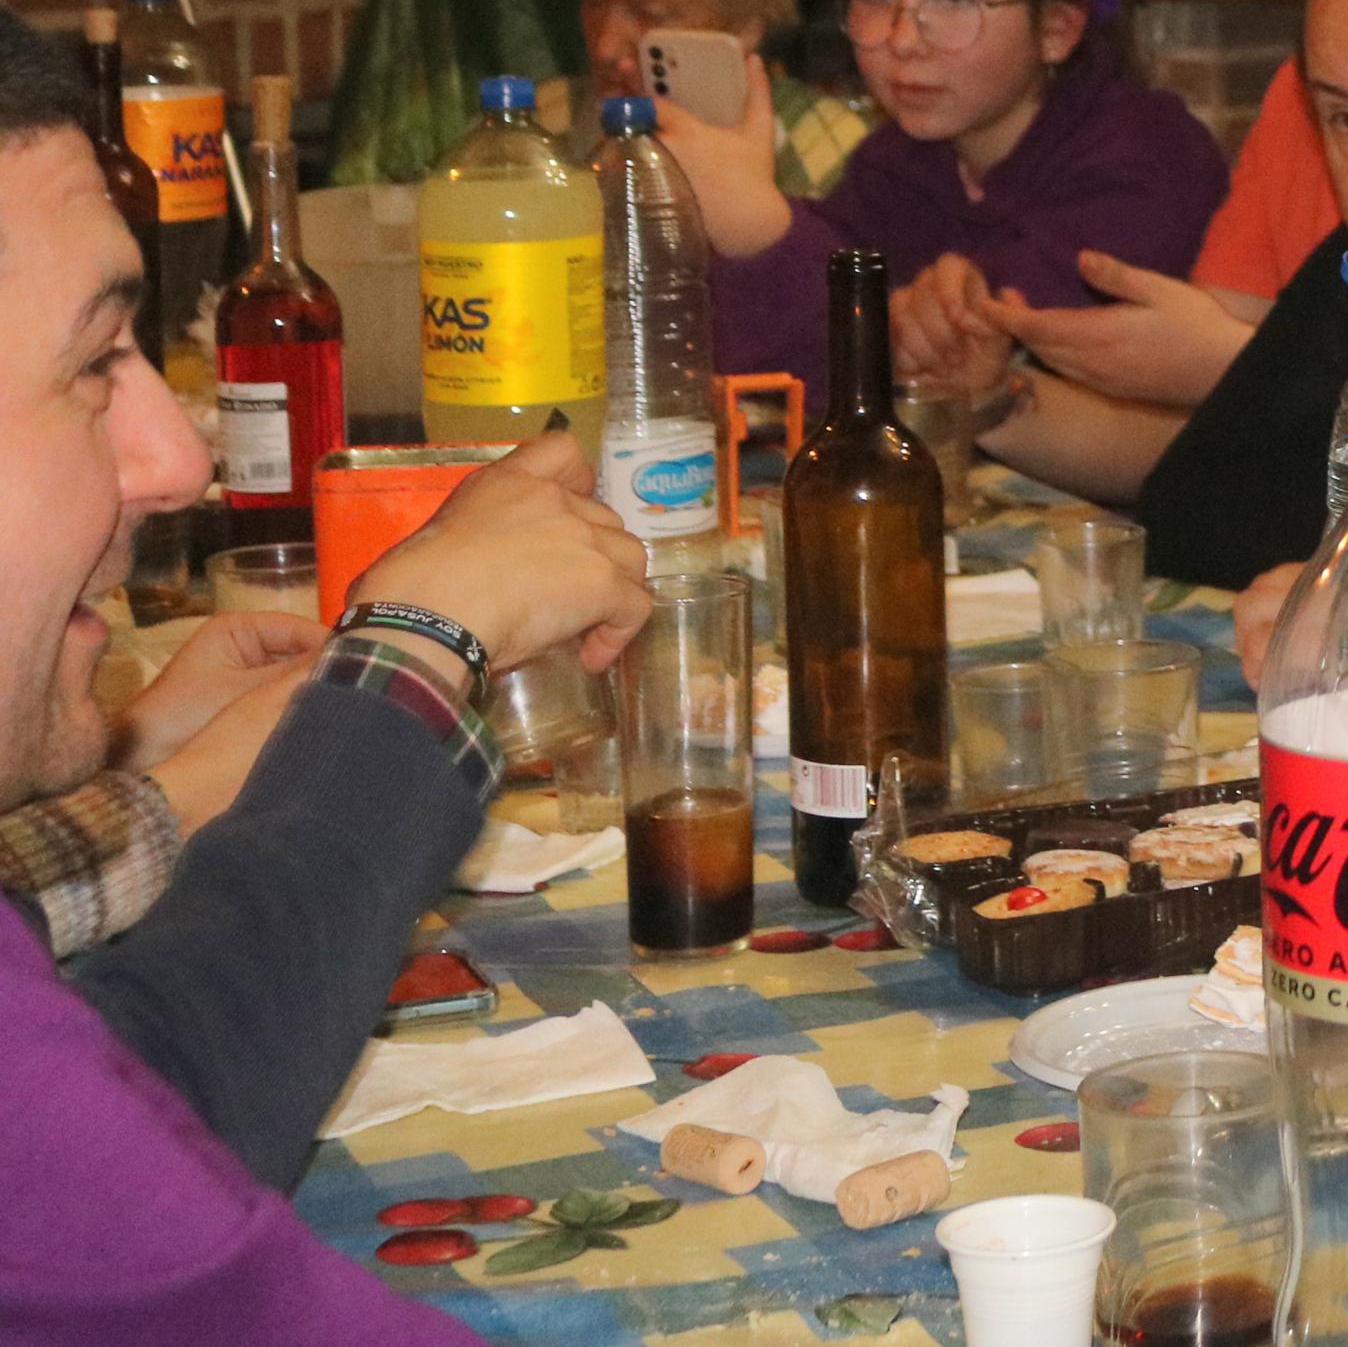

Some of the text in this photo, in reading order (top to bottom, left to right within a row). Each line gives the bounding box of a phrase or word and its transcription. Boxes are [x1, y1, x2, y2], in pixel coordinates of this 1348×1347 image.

[423, 294, 492, 332] KAS
[427, 333, 485, 354] LIMÓN
[1267, 935, 1314, 969] ERO
[1270, 968, 1317, 1002] ZERO
